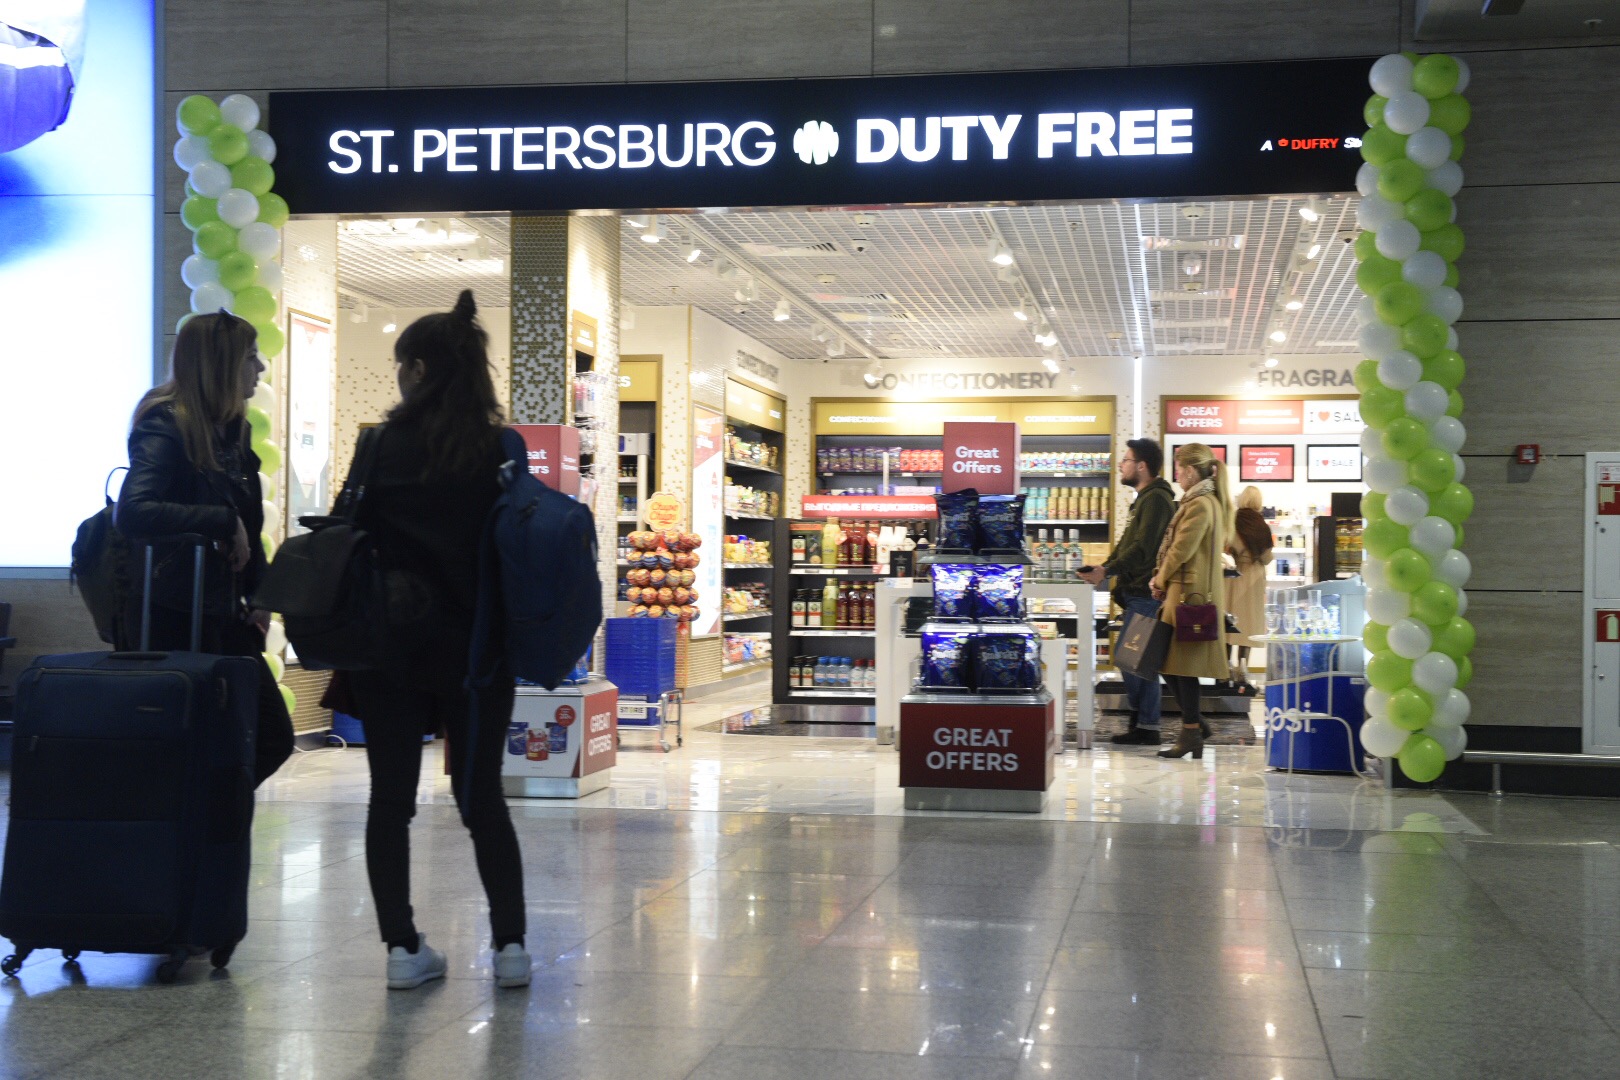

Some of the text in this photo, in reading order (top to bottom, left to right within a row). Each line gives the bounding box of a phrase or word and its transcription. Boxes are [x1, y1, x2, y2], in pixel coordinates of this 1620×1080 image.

[855, 108, 1194, 164] DUTY FREE
[327, 121, 777, 175] ST. PETERSBURG
[1260, 140, 1273, 152] A
[1291, 138, 1340, 150] DUFRY
[1258, 368, 1355, 387] FRAGRA
[1180, 406, 1220, 416] GREAT
[1334, 411, 1360, 423] SAL
[1176, 417, 1224, 428] OFFERS
[526, 448, 548, 460] eat
[955, 445, 1000, 459] Great
[527, 464, 550, 475] ers
[952, 460, 1003, 474] Offers
[934, 727, 1012, 748] GREAT
[926, 751, 1018, 773] OFFERS
